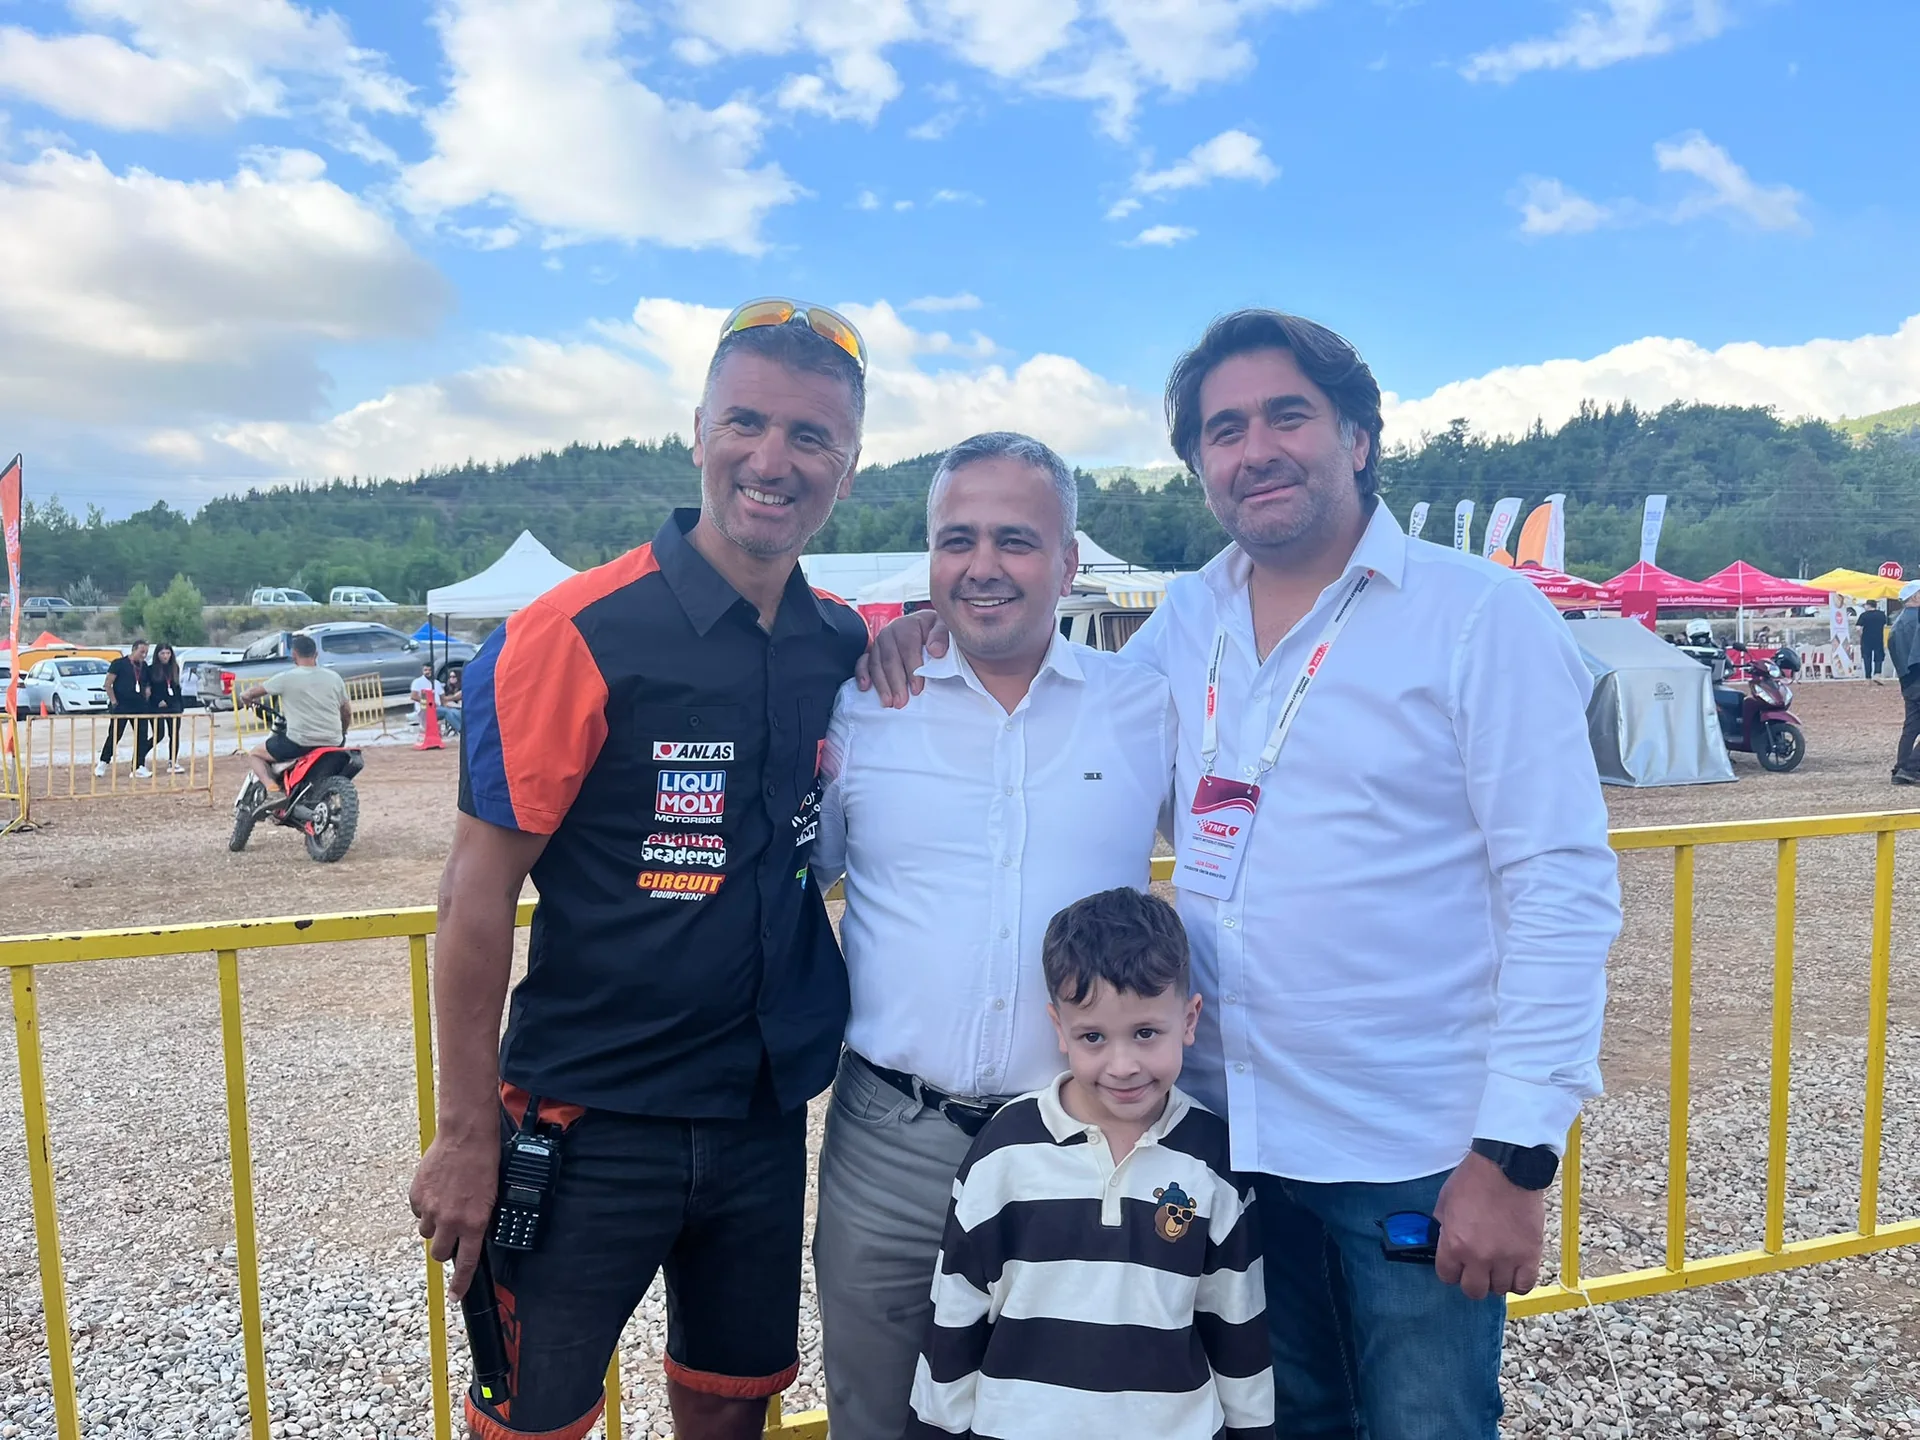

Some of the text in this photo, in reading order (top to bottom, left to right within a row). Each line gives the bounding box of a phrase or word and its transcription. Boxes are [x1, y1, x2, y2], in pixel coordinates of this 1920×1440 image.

[1880, 567, 1900, 577] DUR
[676, 744, 732, 759] ANLAS
[661, 773, 722, 792] LIQUI
[659, 793, 723, 813] MOLY
[654, 814, 723, 824] MOTORBIKE
[1208, 821, 1226, 834] TMF
[642, 845, 726, 867] academy
[638, 871, 724, 892] CIRCUIT
[650, 890, 706, 901] EQUIPMENT
